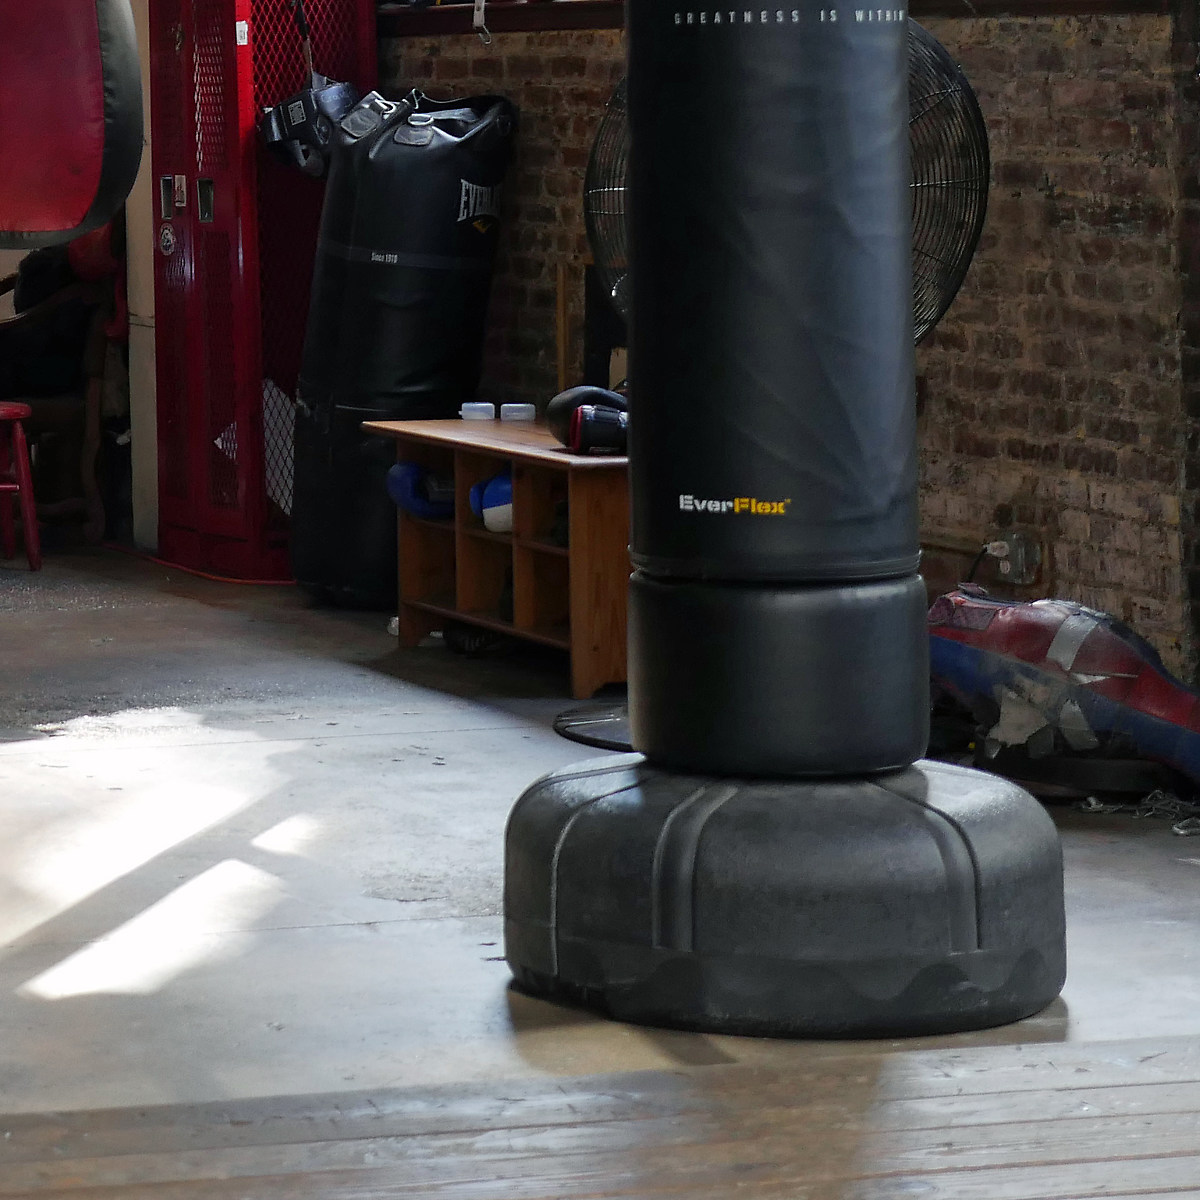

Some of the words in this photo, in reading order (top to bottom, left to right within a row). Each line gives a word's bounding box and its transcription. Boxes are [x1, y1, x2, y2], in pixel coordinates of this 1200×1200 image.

[674, 10, 800, 25] GREATNESS
[820, 9, 837, 23] IS
[679, 494, 786, 514] EverFlex
